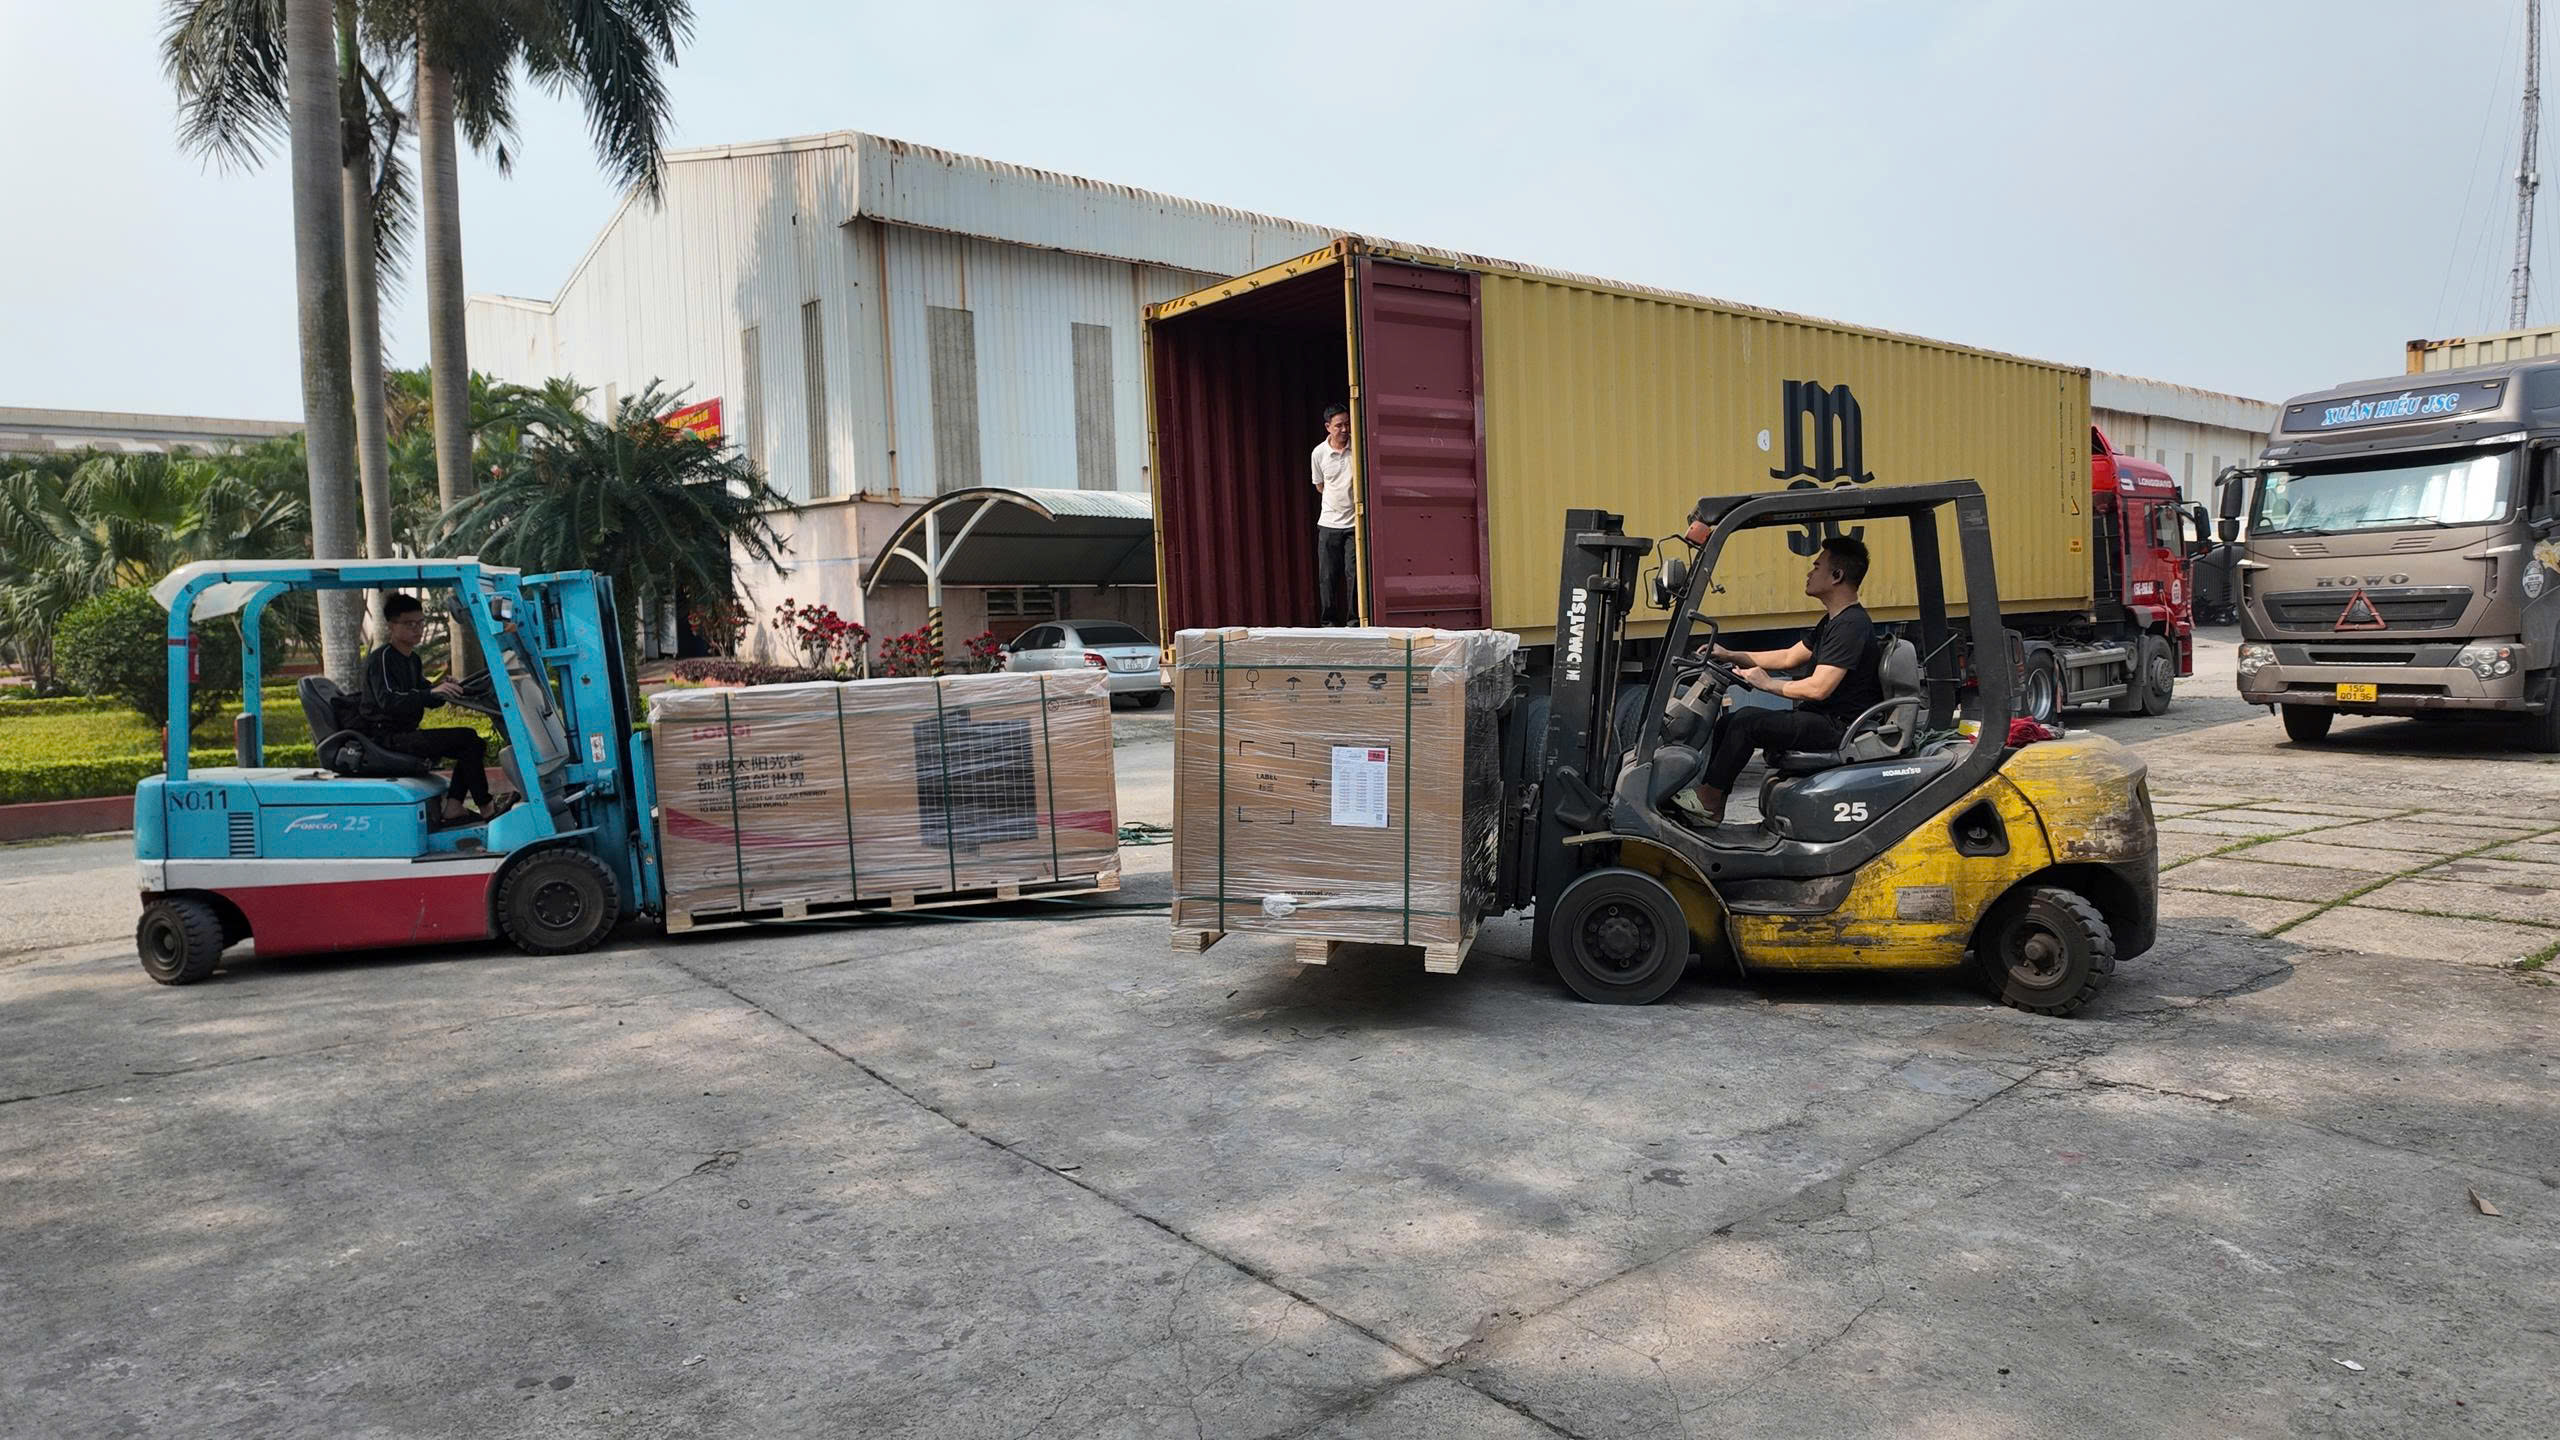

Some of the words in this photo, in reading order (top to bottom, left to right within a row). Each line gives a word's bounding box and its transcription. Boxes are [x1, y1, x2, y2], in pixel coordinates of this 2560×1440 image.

[2321, 399, 2377, 426] XUÂN
[2421, 393, 2460, 414] JSC
[2316, 573, 2410, 588] HOWO
[1565, 587, 1588, 681] KOMATSU
[1882, 767, 1922, 777] KOMATSU
[169, 789, 228, 812] NO.11
[1833, 802, 1869, 822] 25
[343, 816, 371, 832] 25
